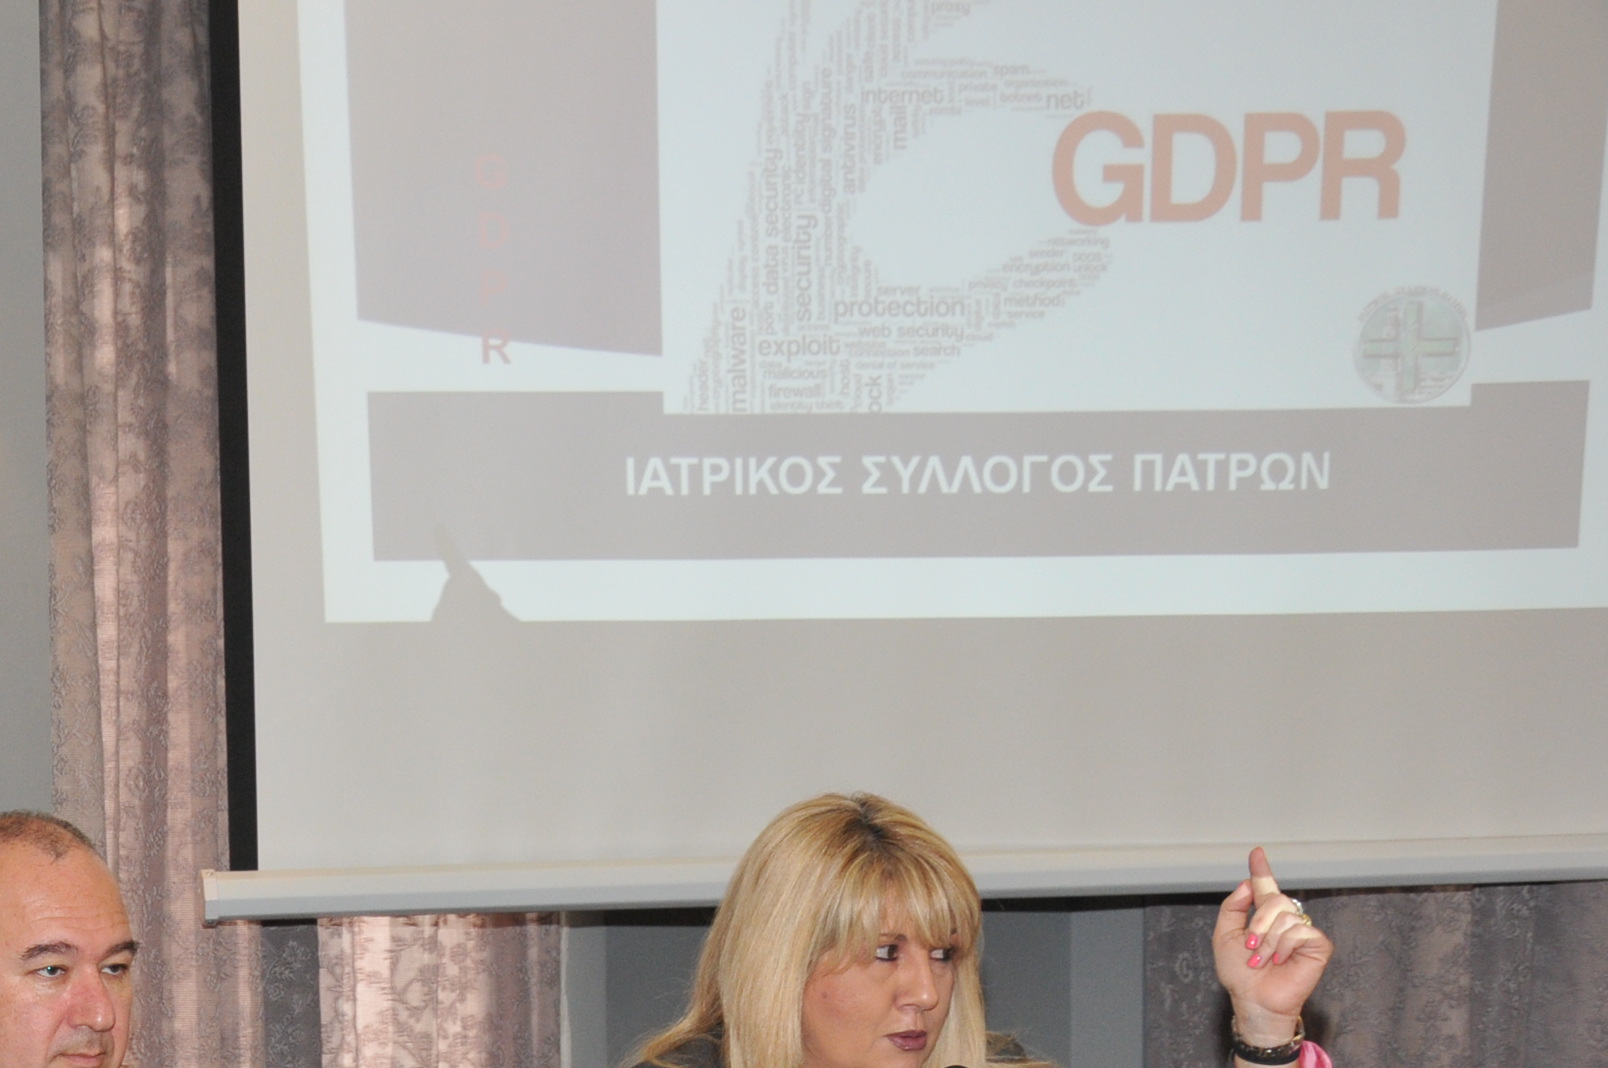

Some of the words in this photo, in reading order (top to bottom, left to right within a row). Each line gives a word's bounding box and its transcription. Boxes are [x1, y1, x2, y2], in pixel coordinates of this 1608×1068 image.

[819, 67, 836, 154] signature
[861, 87, 944, 105] internet
[1046, 91, 1086, 110] net
[793, 113, 810, 184] identity
[840, 103, 857, 195] antivirus
[890, 105, 908, 150] mail
[819, 158, 837, 214] digital
[1051, 109, 1407, 227] GDPR
[762, 148, 783, 238] security
[761, 245, 779, 294] data
[792, 215, 818, 322] security
[834, 295, 965, 323] protection
[1004, 294, 1061, 307] method
[758, 333, 840, 362] exploit
[859, 323, 891, 338] web
[896, 323, 964, 342] security
[913, 344, 960, 356] search
[726, 307, 747, 413] malware
[763, 366, 828, 379] malicious
[768, 383, 822, 398] firewall
[626, 455, 843, 497] ΙΑΤΡΙΚΟΣ
[861, 452, 1114, 496] ΣΥΛΛΟΓΟΣ
[1133, 449, 1330, 493] ΠΑΤΡΩΝ
